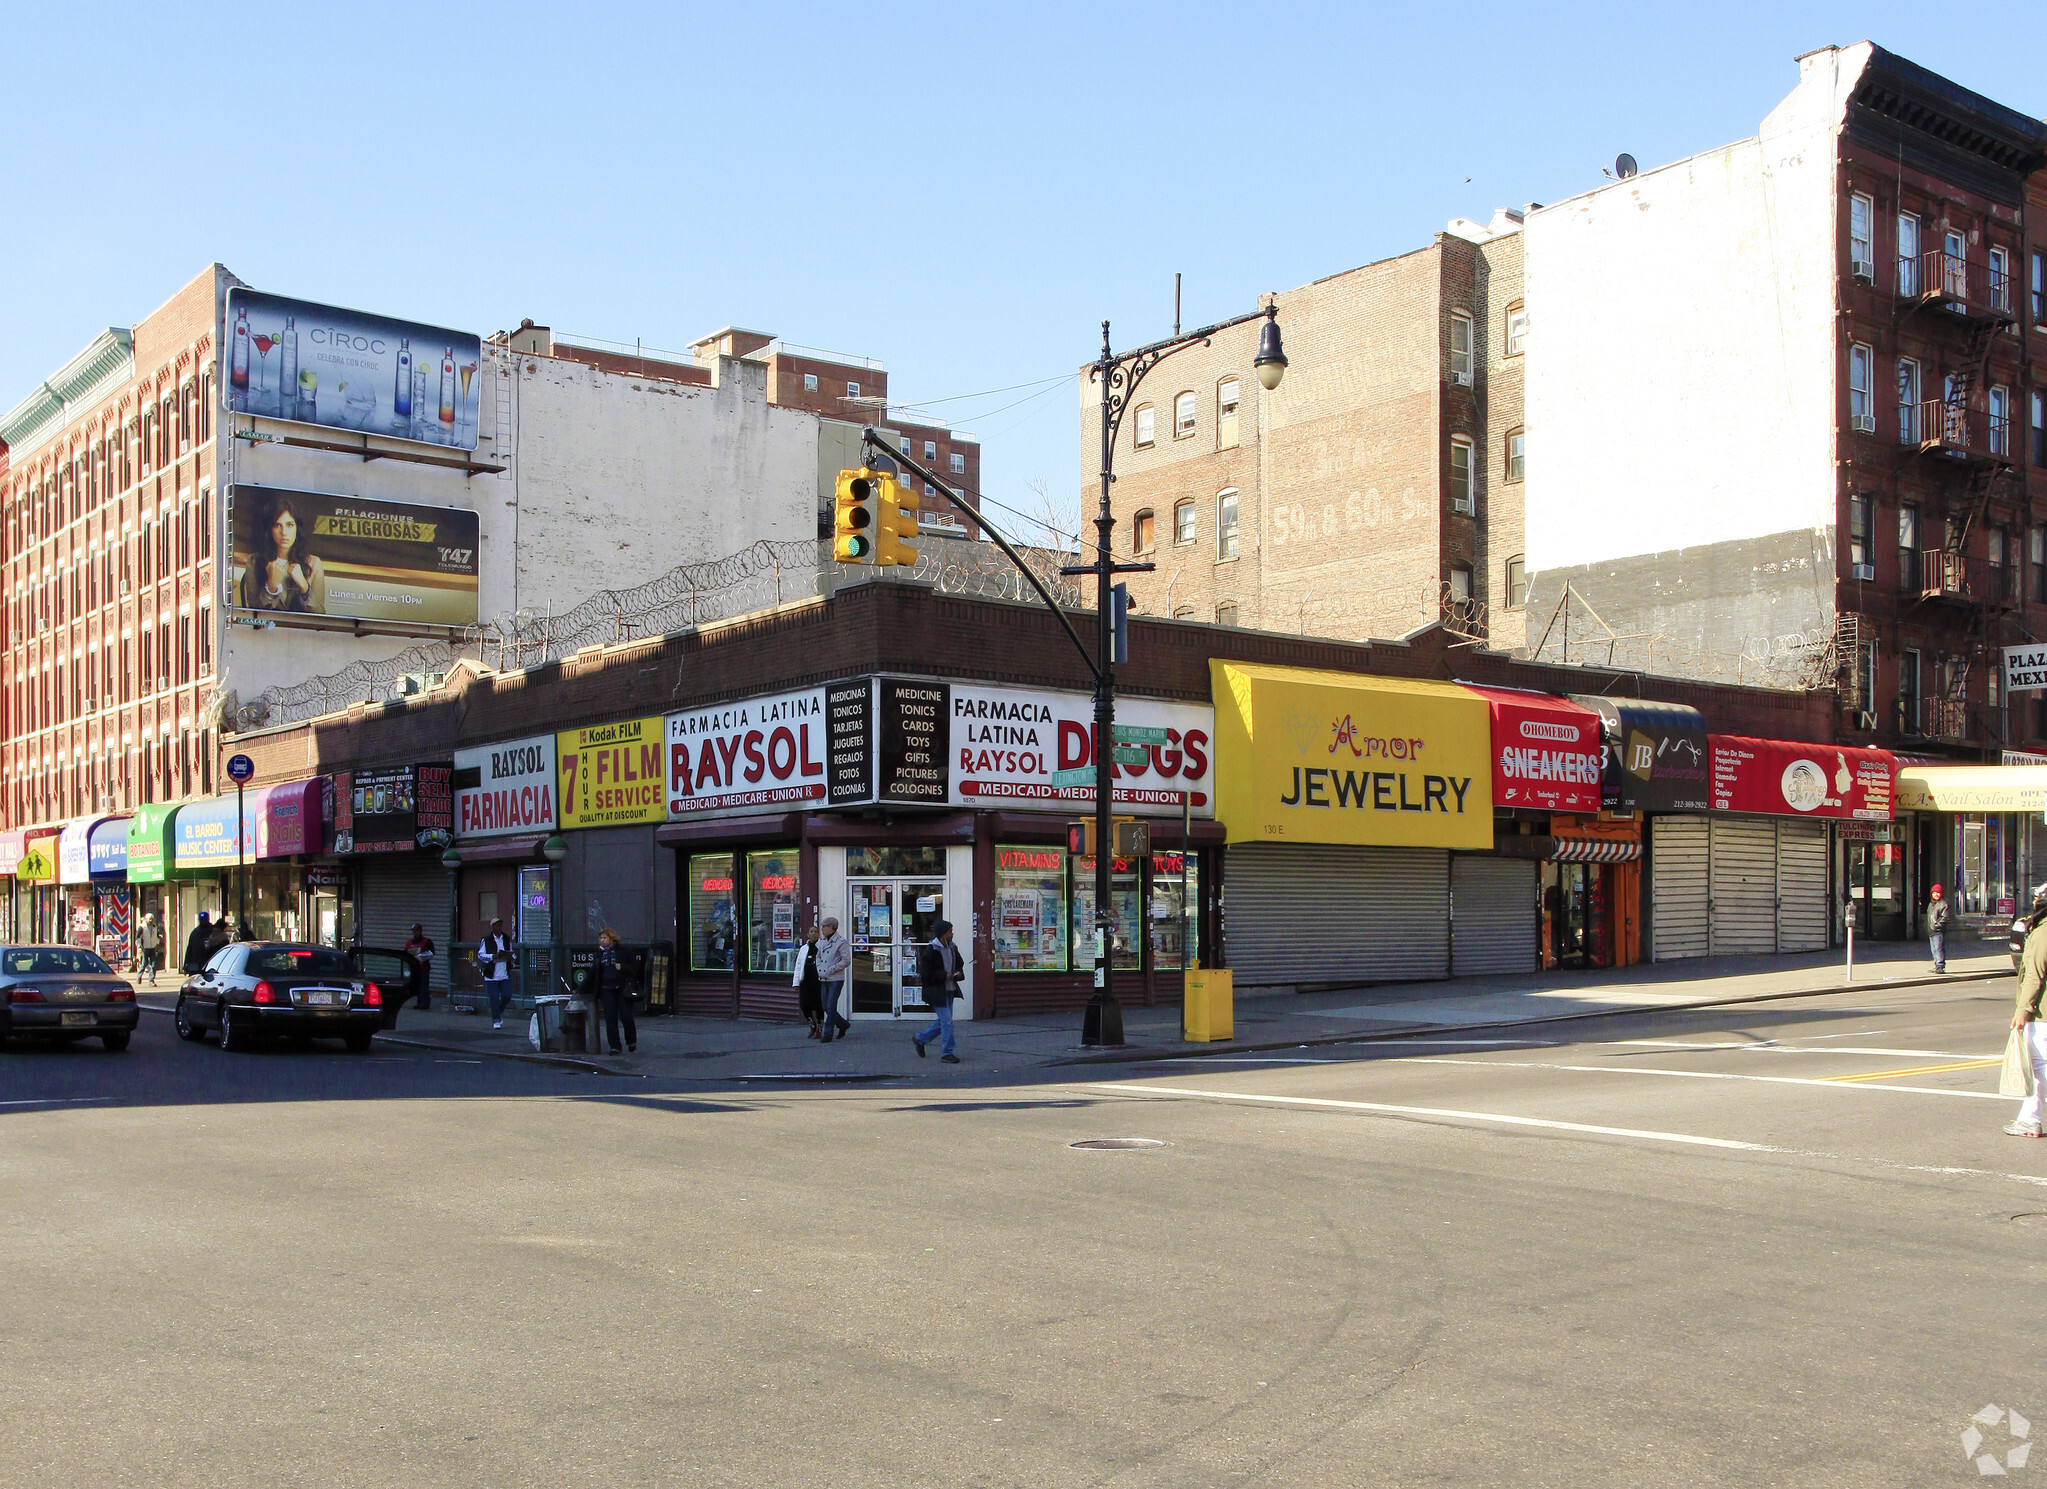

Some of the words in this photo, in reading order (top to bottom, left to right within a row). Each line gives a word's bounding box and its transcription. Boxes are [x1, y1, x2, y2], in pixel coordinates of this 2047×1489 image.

[346, 358, 358, 366] CON
[336, 508, 414, 523] RELACIONES
[329, 519, 421, 540] PELIGROSAS
[330, 589, 356, 599] Lunes
[366, 592, 398, 602] Viernes
[400, 594, 422, 604] 10PM
[2008, 652, 2047, 668] PLAZ
[830, 688, 866, 703] MEDICINAS
[896, 688, 942, 702] MEDICINE
[672, 709, 748, 738] FARMACIA
[762, 697, 821, 723] LATINA
[834, 704, 862, 718] TONICOS
[900, 704, 935, 717] TONICS
[954, 698, 1052, 724] FARMACIA
[589, 728, 617, 743] Kodak
[619, 723, 642, 738] FILM
[834, 720, 863, 734] TARJETAS
[902, 720, 934, 732] CARDS
[1114, 726, 1126, 737] LUIS
[906, 736, 930, 748] TOYS
[968, 724, 1040, 746] LATINA
[1329, 714, 1424, 761] Amor
[834, 736, 864, 750] JUGUETES
[1058, 720, 1208, 780] DGS
[492, 745, 544, 780] RAYSOL
[834, 751, 864, 765] REGALOS
[905, 752, 930, 764] GIFTS
[1114, 748, 1119, 762] E
[1124, 749, 1135, 763] 116
[1630, 744, 1652, 771] JB
[1739, 751, 1754, 759] Dinero
[597, 742, 662, 784] FILM
[1502, 746, 1598, 785] SNEAKERS
[418, 767, 452, 782] BUY
[839, 768, 860, 780] FOTOS
[896, 767, 938, 780] PICTURES
[1056, 770, 1086, 785] LEXINGTON
[418, 782, 451, 798] SELL
[562, 754, 578, 814] 7
[832, 782, 866, 796] COLONIAS
[890, 782, 943, 796] COLOGNES
[1281, 766, 1472, 814] JEWELRY
[596, 784, 662, 810] SERVICE
[678, 798, 718, 812] MEDICAID
[722, 792, 768, 806] MEDICARE
[772, 788, 802, 800] UNION
[978, 782, 1052, 798] MEDICAID
[1058, 787, 1128, 801] MEDIRE
[1135, 790, 1180, 804] UNION
[1715, 789, 1733, 797] Copias
[1937, 792, 1972, 806] Nail
[1972, 792, 2014, 806] Salon
[274, 802, 298, 818] French
[418, 797, 450, 812] TRADE
[462, 784, 552, 832] FARMACIA
[418, 812, 451, 827] REPAIR
[580, 812, 604, 824] QUALITY
[606, 812, 614, 820] AT
[614, 808, 647, 820] DISCOUNT
[185, 824, 194, 839] EL
[195, 822, 223, 838] BARRIO
[271, 818, 302, 844] Nails
[1264, 824, 1277, 834] 130
[1278, 825, 1285, 835] E.
[1838, 822, 1876, 831] TULCINGO
[1838, 831, 1875, 840] EXPRESS
[129, 841, 160, 859] BOTANICA
[178, 840, 202, 856] MUSIC
[204, 838, 232, 854] CENTER
[999, 852, 1060, 869] VITAMINS
[1153, 857, 1183, 872] TOYS
[308, 874, 347, 884] Nails
[532, 880, 546, 890] FAX
[702, 878, 732, 891] MEDICAID
[762, 876, 795, 890] MEDICARE
[98, 886, 124, 894] Nails
[530, 895, 546, 906] COPY
[577, 973, 584, 982] 6
